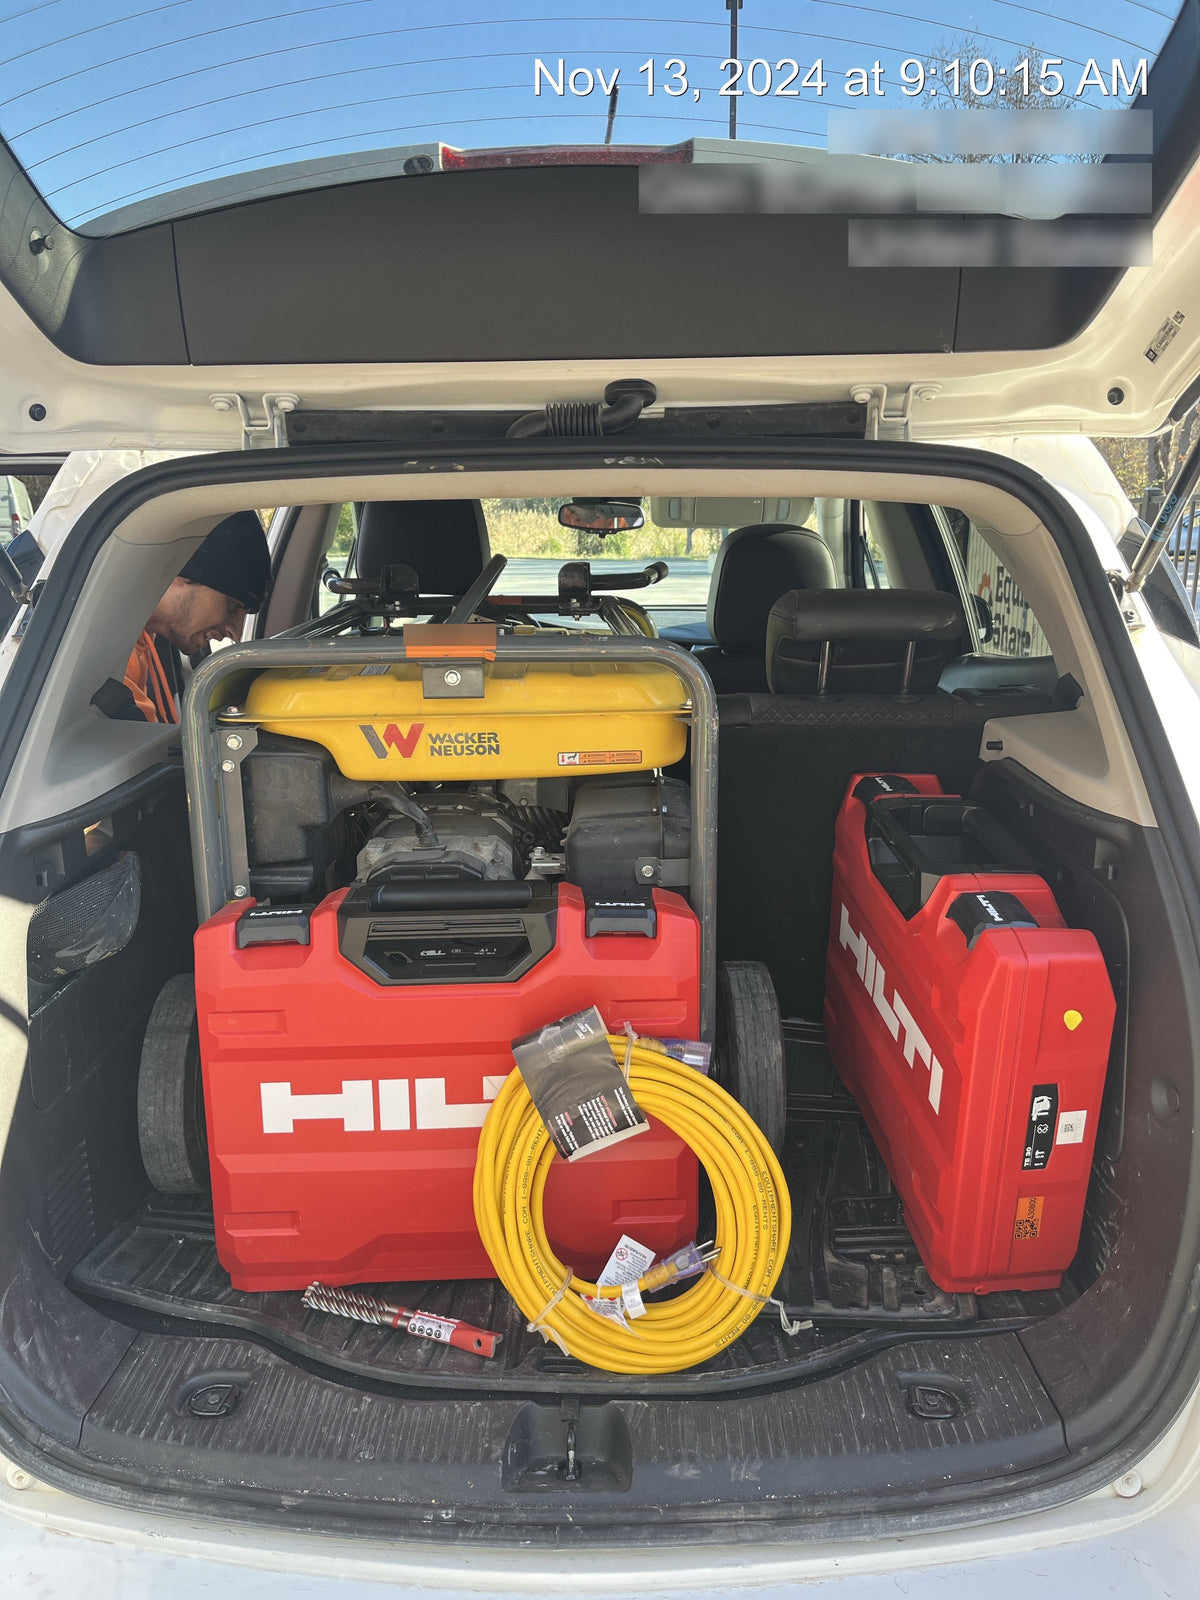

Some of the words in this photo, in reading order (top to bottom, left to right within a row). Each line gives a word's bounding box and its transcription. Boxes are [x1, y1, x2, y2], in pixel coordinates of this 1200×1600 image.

[427, 732, 500, 744] WACKER
[429, 744, 500, 756] NEUSON
[976, 894, 1004, 921] HILTI
[839, 902, 944, 1116] HILTI
[260, 1076, 508, 1134] HIL
